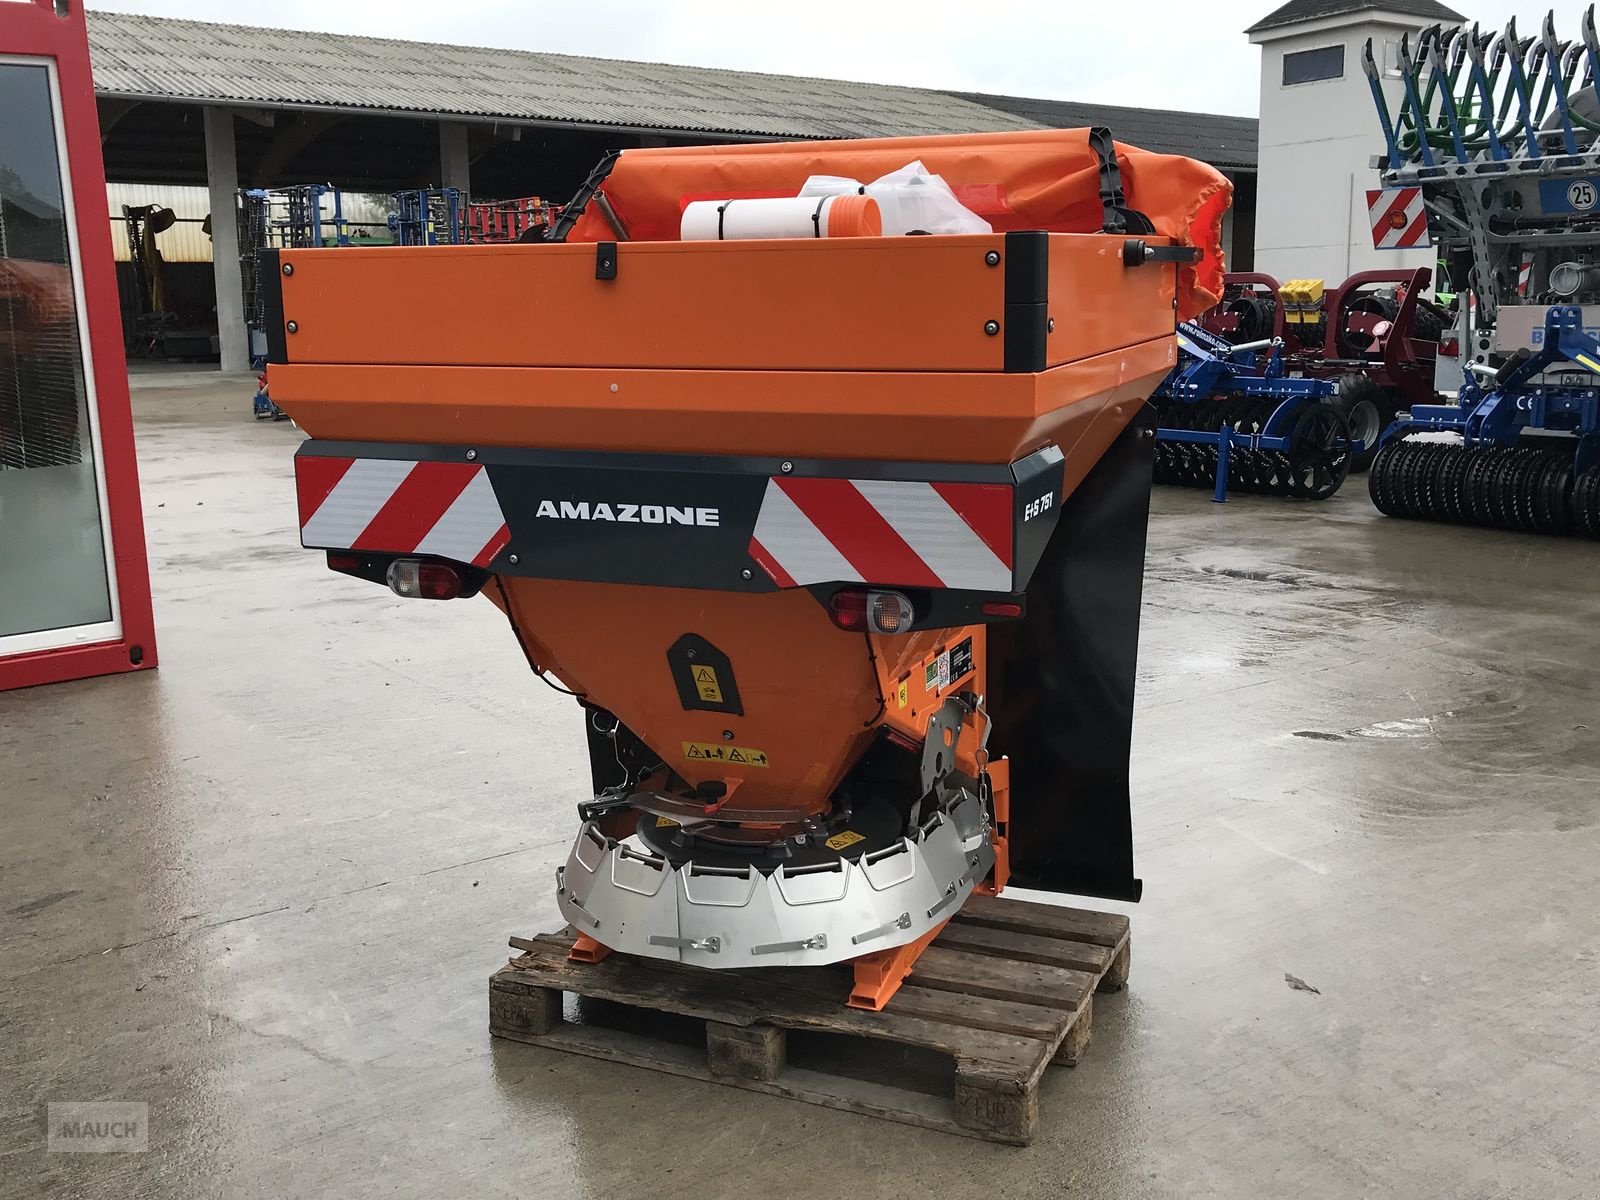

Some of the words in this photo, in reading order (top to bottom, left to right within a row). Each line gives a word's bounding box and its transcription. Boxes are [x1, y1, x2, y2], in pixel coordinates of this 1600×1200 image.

[1572, 185, 1592, 205] 25
[535, 500, 720, 527] AMAZONE
[1024, 498, 1040, 522] E+S
[1040, 491, 1054, 513] 751
